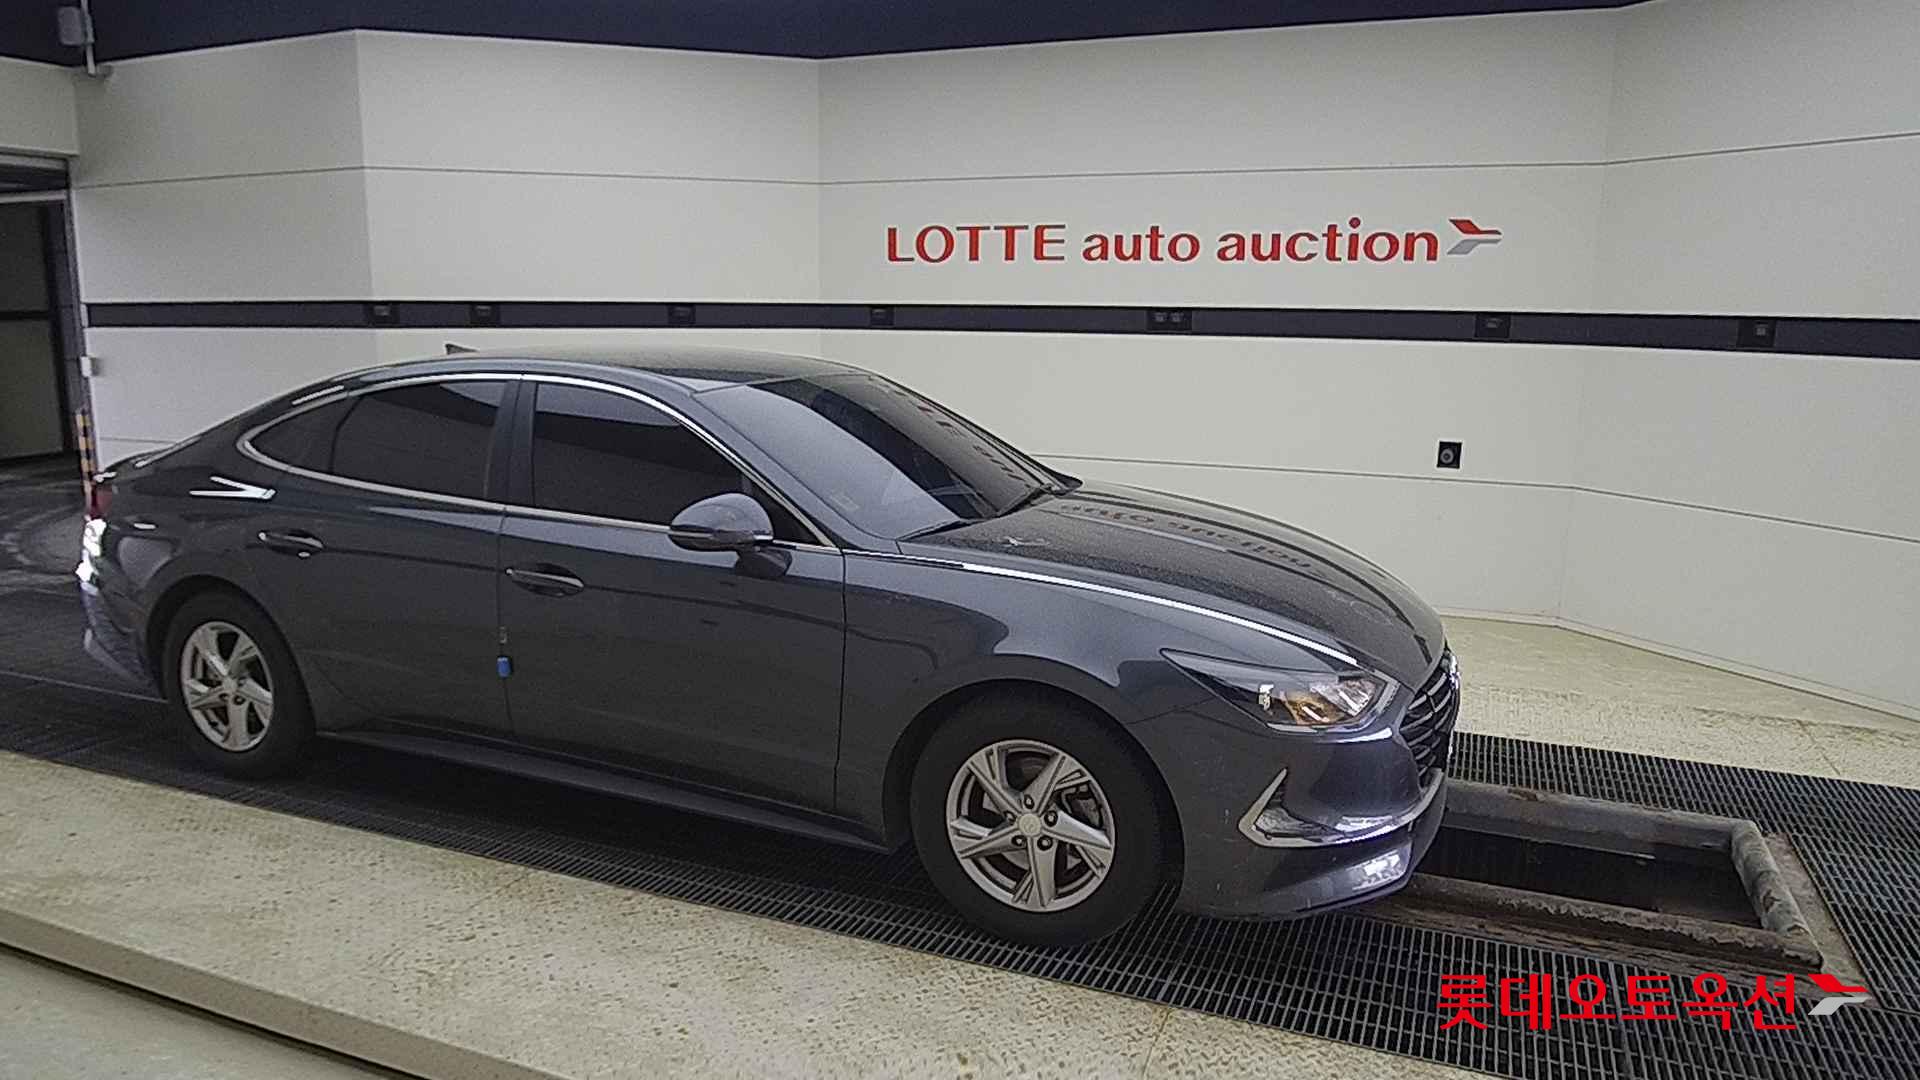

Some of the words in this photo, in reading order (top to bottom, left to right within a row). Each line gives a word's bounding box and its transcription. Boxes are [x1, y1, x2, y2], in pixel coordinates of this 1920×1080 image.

[887, 225, 1066, 263] LOTTE
[1082, 225, 1201, 262] auto
[1216, 218, 1439, 262] auction
